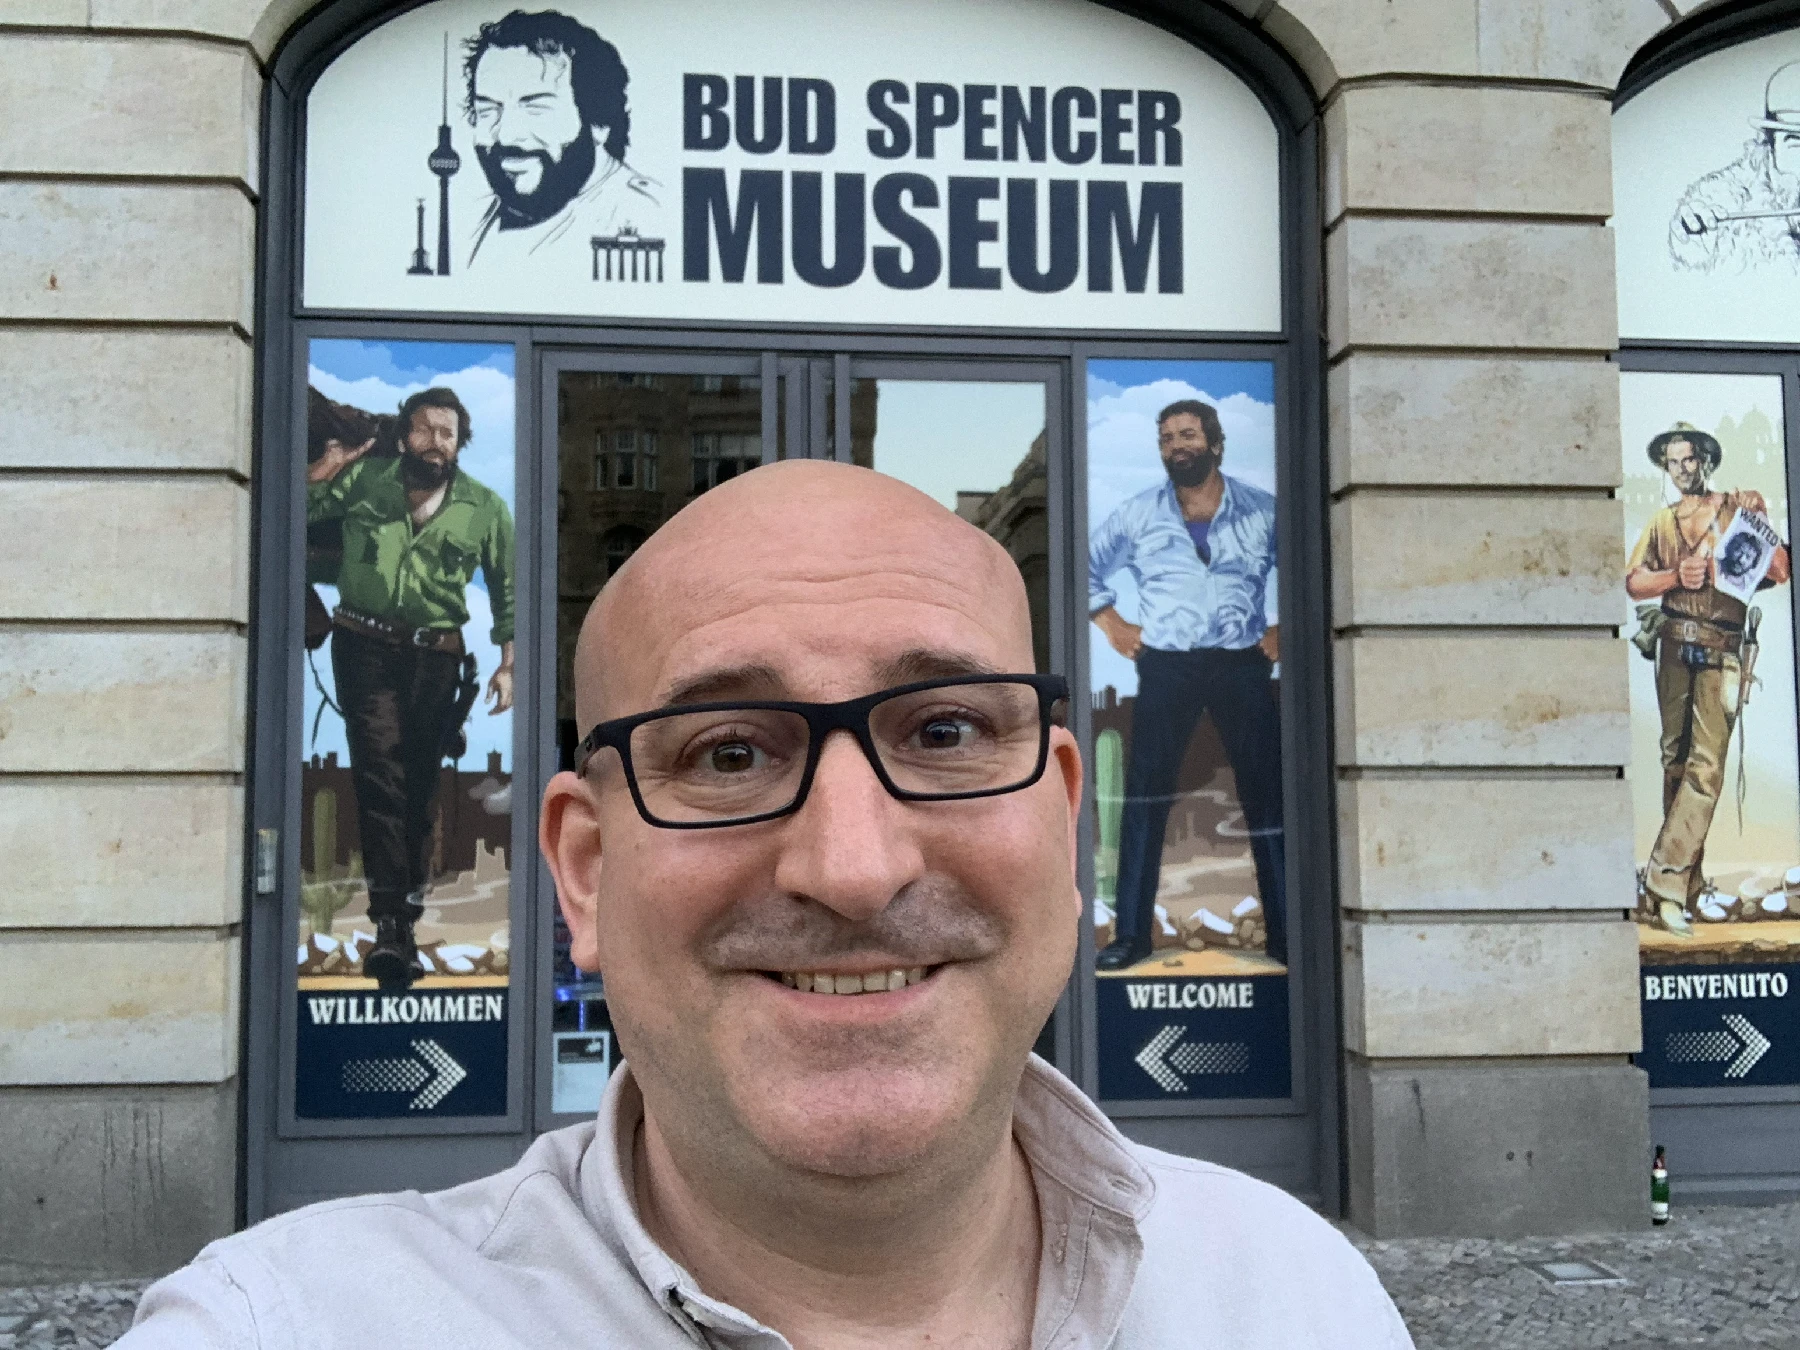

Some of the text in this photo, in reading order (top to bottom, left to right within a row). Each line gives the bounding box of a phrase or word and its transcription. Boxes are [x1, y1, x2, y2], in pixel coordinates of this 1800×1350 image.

[682, 73, 1183, 167] BUD SPENCER
[682, 166, 1184, 295] MUSEUM
[1740, 506, 1780, 547] WANTED
[1125, 981, 1255, 1010] WELCOME
[1644, 972, 1789, 1001] BENVENUTO
[307, 994, 504, 1025] WILLKOMMEN
